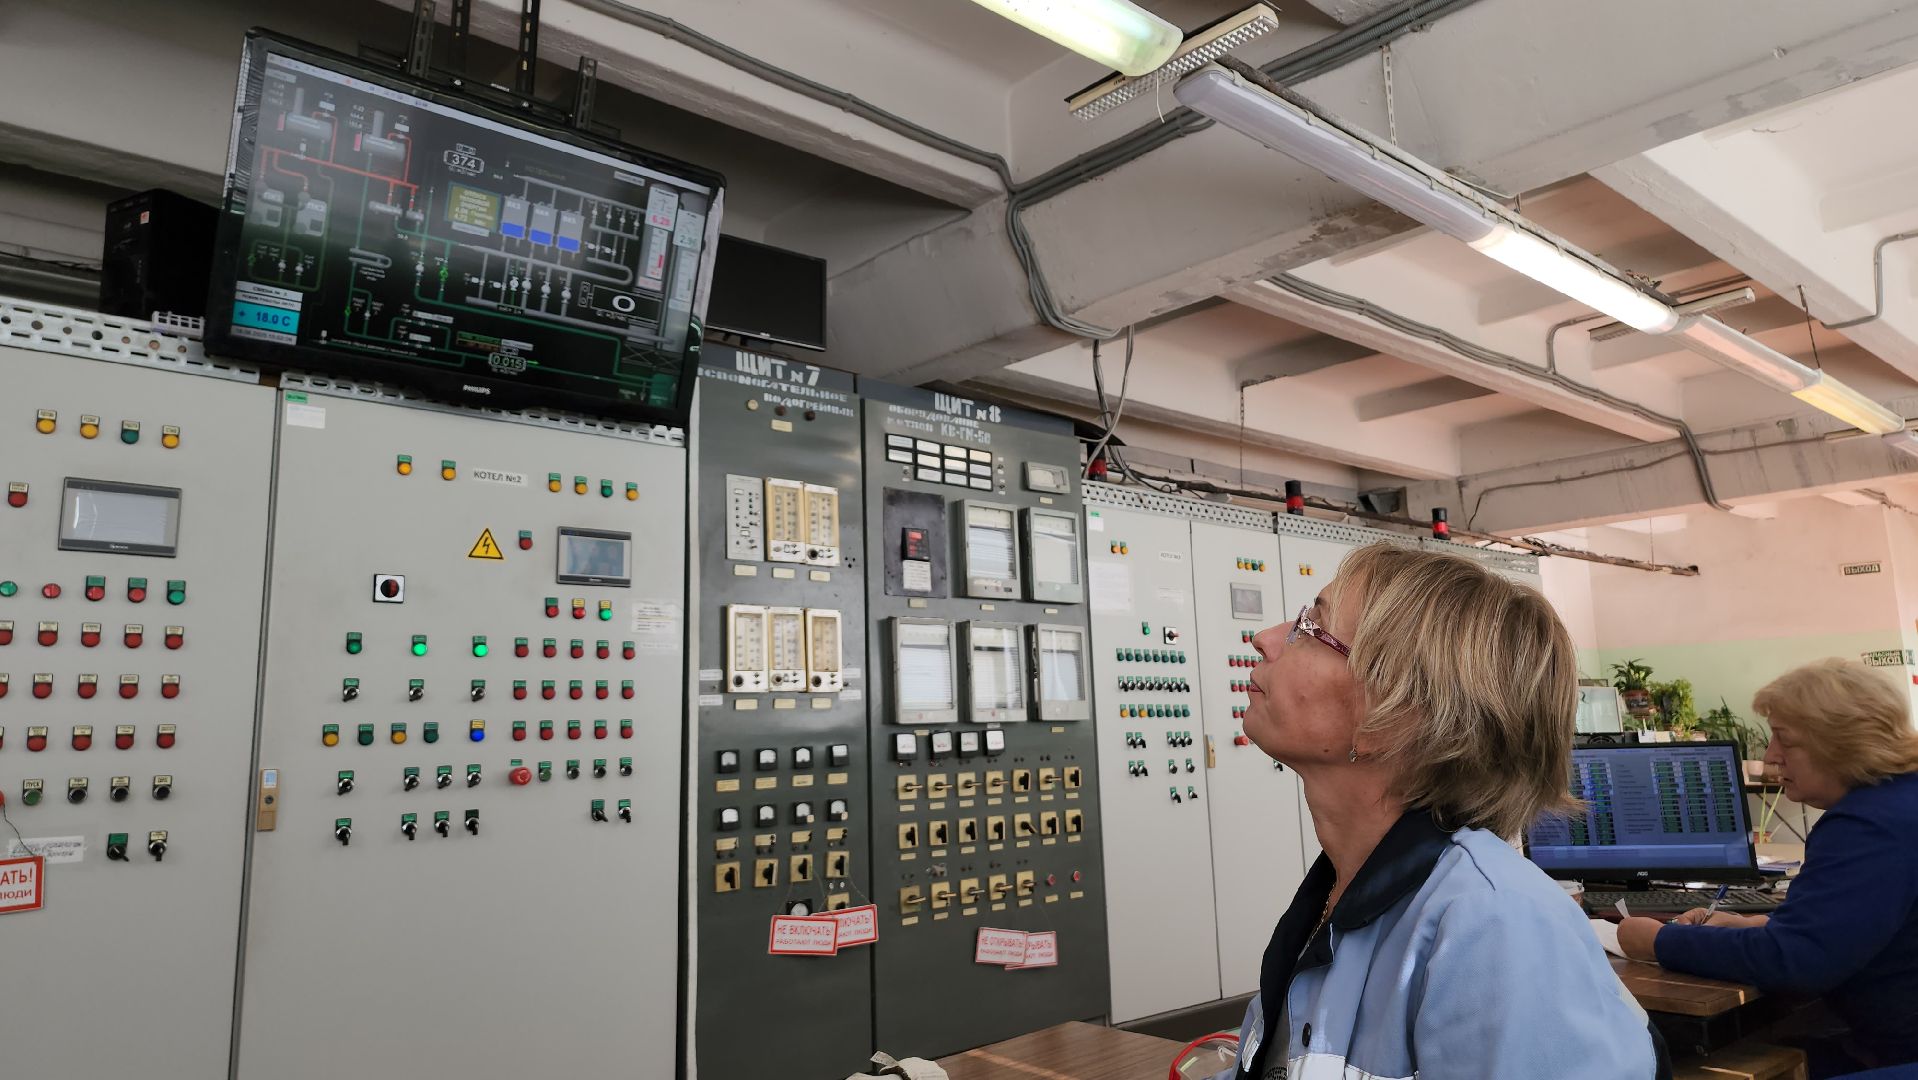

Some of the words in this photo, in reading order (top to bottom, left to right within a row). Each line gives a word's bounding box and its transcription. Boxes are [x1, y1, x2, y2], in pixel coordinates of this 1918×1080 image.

[451, 154, 476, 171] 374
[257, 310, 279, 324] 18.0
[493, 355, 522, 369] 0.015
[735, 350, 788, 379] ЩИТ
[463, 384, 491, 395] PHILIPS
[934, 392, 975, 418] ЩИТ
[473, 470, 503, 481] КОТЕЛ
[1844, 563, 1880, 575] ВЫХОД
[777, 925, 786, 935] НЕ
